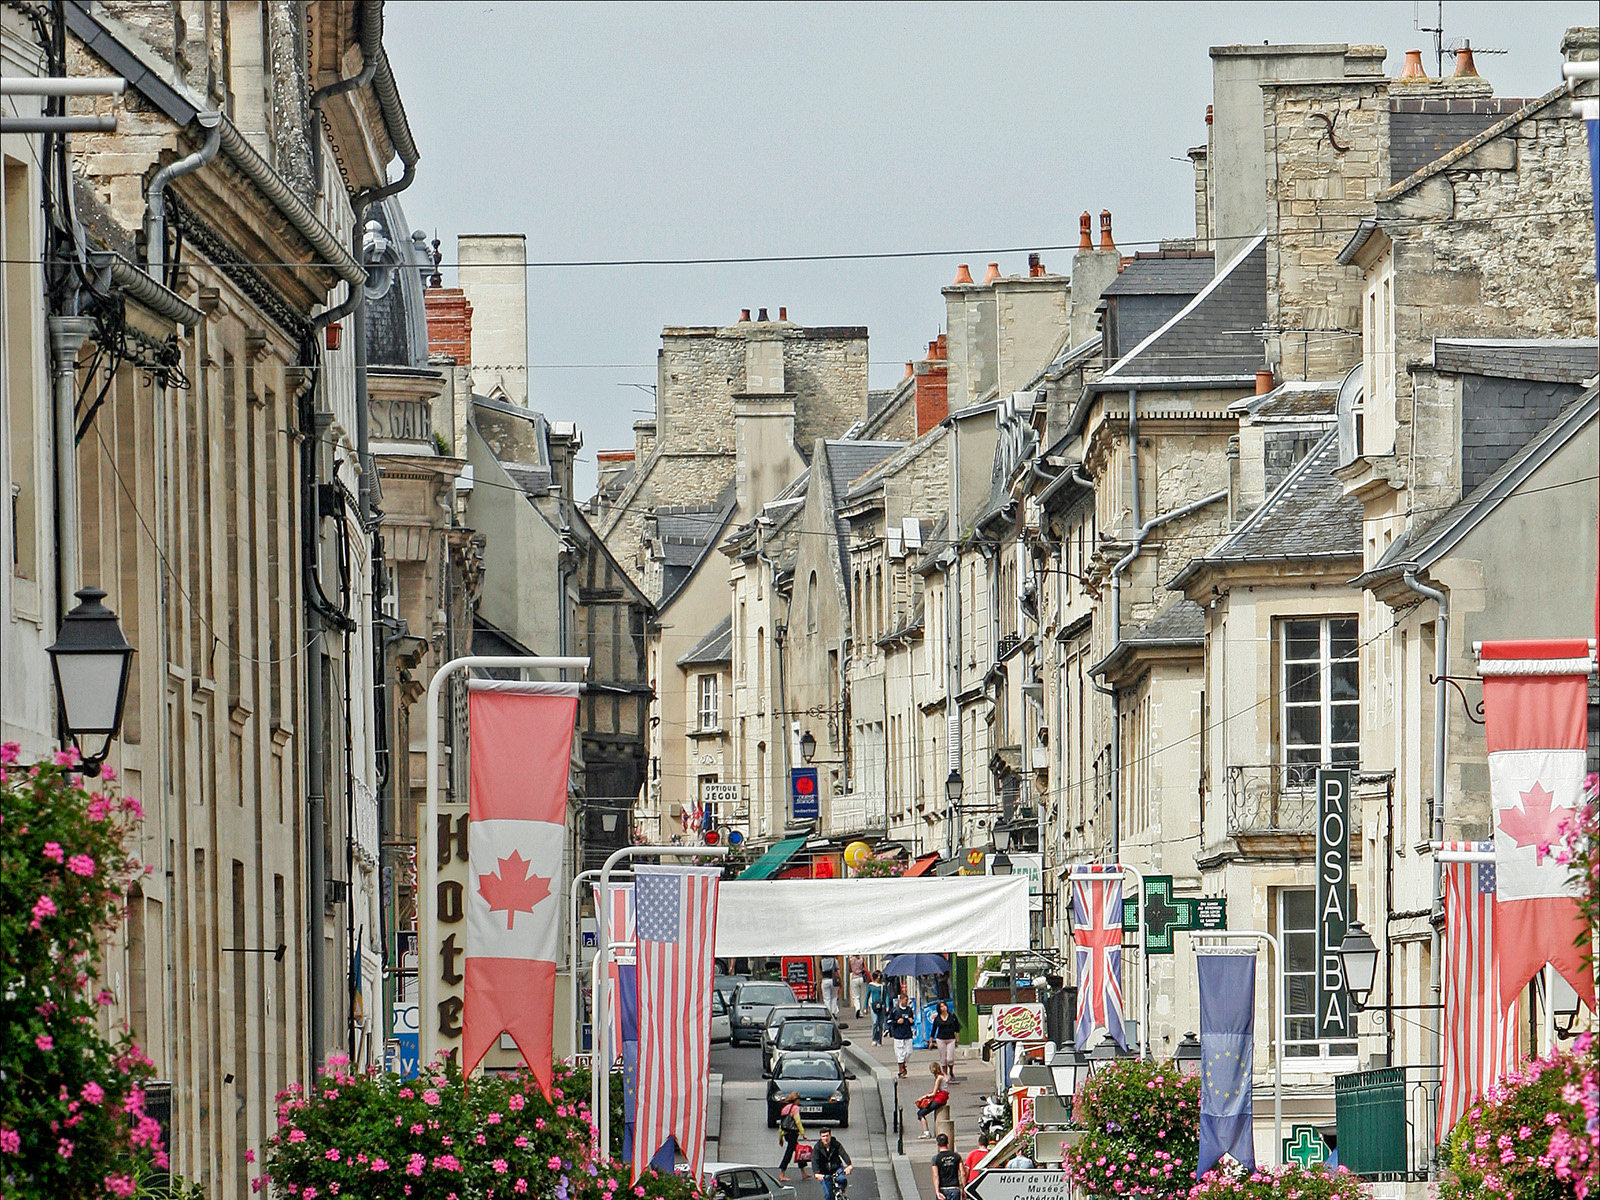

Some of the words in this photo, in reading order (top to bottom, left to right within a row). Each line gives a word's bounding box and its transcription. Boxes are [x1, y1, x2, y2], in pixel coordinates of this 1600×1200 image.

[1322, 779, 1345, 1030] ROSALBA
[1000, 1175, 1025, 1184] Hôtel
[1028, 1175, 1039, 1184] de
[1043, 1175, 1063, 1184] Vill
[1028, 1185, 1064, 1193] Musées
